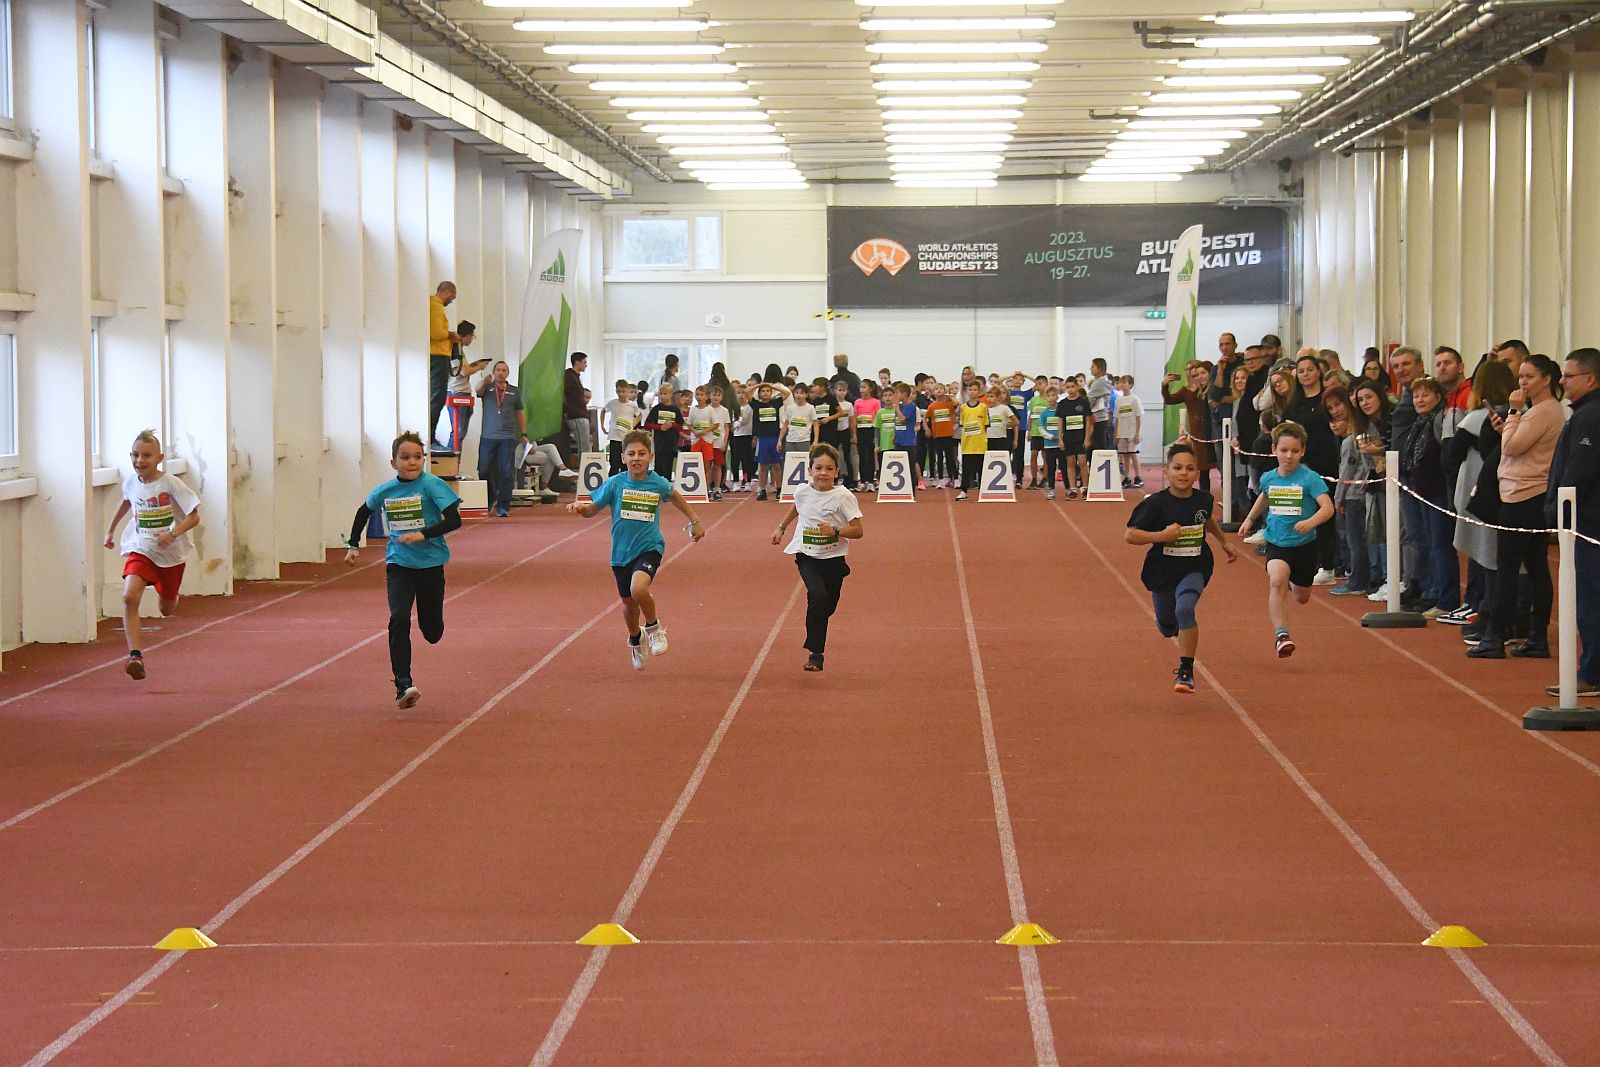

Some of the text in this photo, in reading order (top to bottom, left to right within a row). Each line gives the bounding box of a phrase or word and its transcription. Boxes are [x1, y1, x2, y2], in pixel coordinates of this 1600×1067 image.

[918, 243, 998, 252] WORLD ATHLETICS
[1049, 231, 1087, 245] 2023.
[918, 252, 998, 260] CHAMPIONSHIPS
[919, 261, 999, 270] BUDAPEST 23
[1024, 246, 1113, 264] AUGUSZTUS
[1136, 250, 1262, 274] ATLKAI VB
[584, 462, 604, 492] 6
[680, 462, 700, 492] 5
[787, 461, 809, 486] 4
[886, 461, 906, 492] 3
[987, 460, 1008, 491] 2
[1097, 459, 1111, 490] 1
